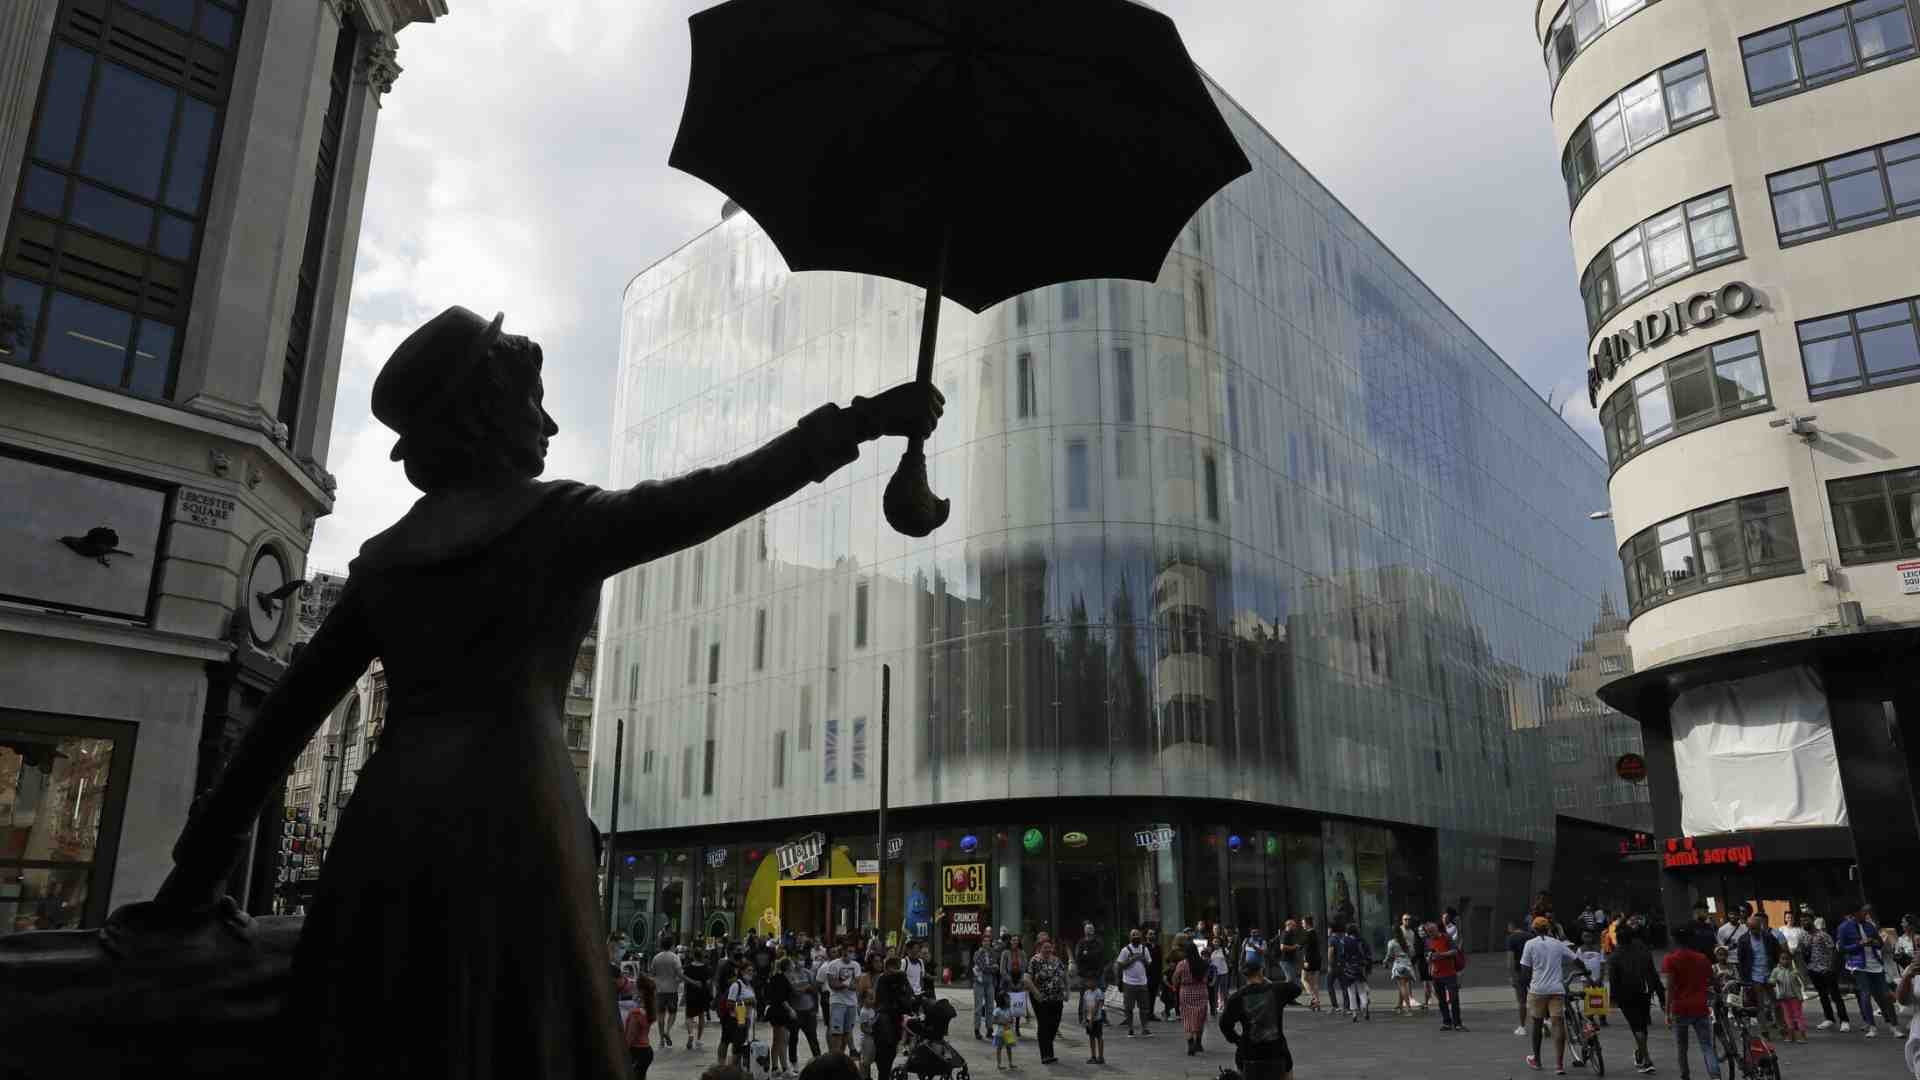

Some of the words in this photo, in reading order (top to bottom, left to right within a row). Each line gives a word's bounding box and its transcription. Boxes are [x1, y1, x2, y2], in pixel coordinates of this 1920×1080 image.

[179, 490, 235, 512] LEICESTER
[182, 502, 229, 521] SQUARE
[953, 912, 979, 922] CRUNCHY
[951, 922, 982, 936] CARAMEL
